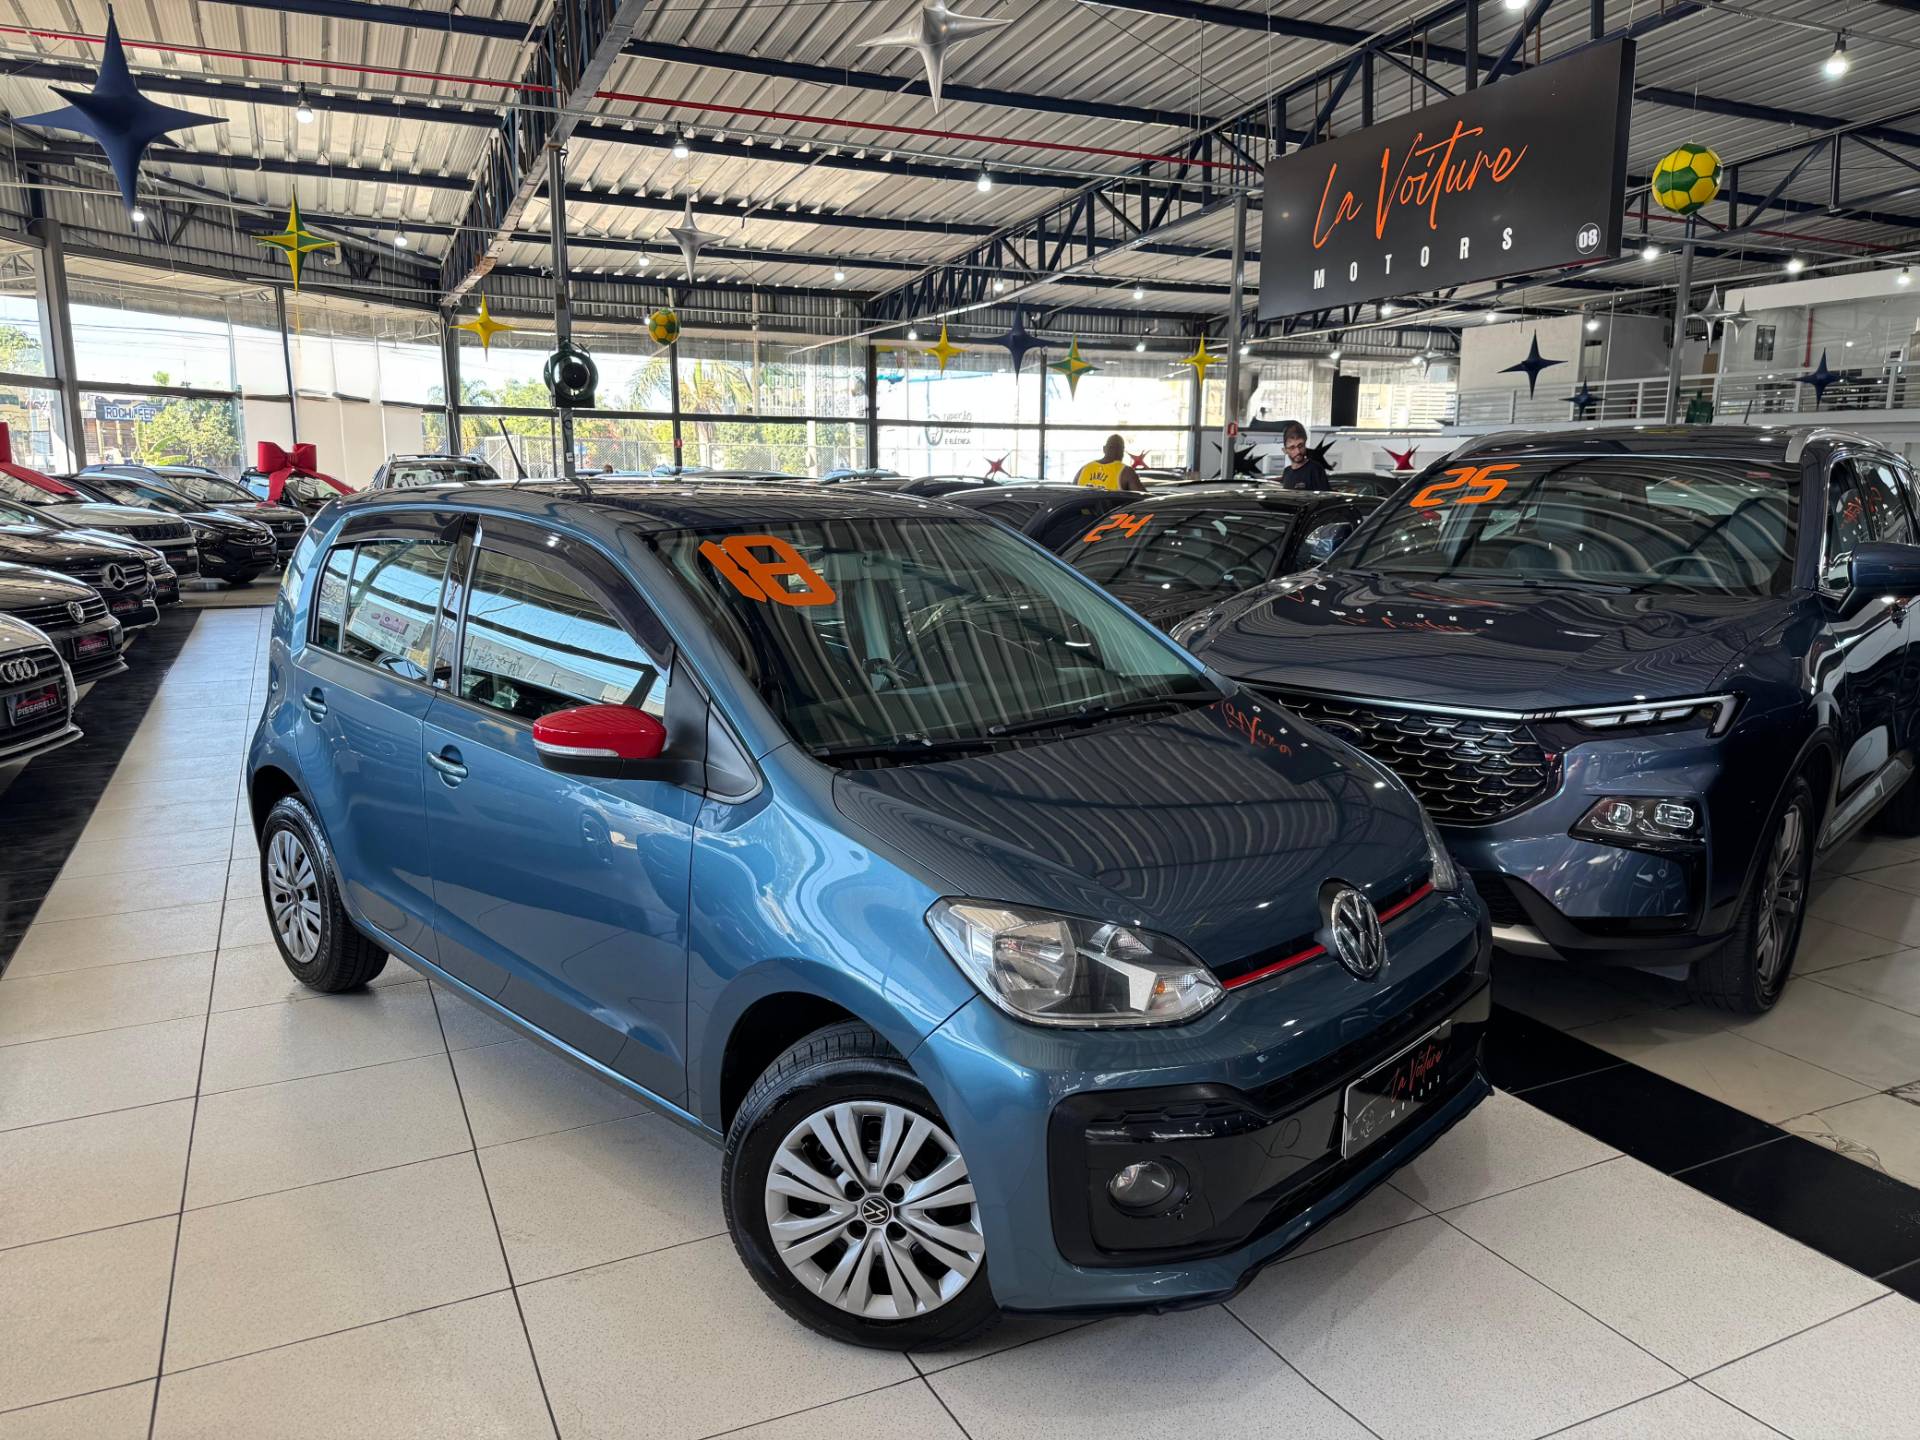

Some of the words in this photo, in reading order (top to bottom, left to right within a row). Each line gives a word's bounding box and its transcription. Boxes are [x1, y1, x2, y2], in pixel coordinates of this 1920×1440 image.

[1312, 162, 1364, 249] La
[1375, 119, 1529, 240] Voiture
[1313, 226, 1513, 290] MOTORS
[1578, 228, 1598, 248] 08
[1409, 463, 1521, 508] 25
[1082, 513, 1155, 543] 24
[698, 534, 836, 607] 18
[16, 697, 57, 717] PISSARELLI
